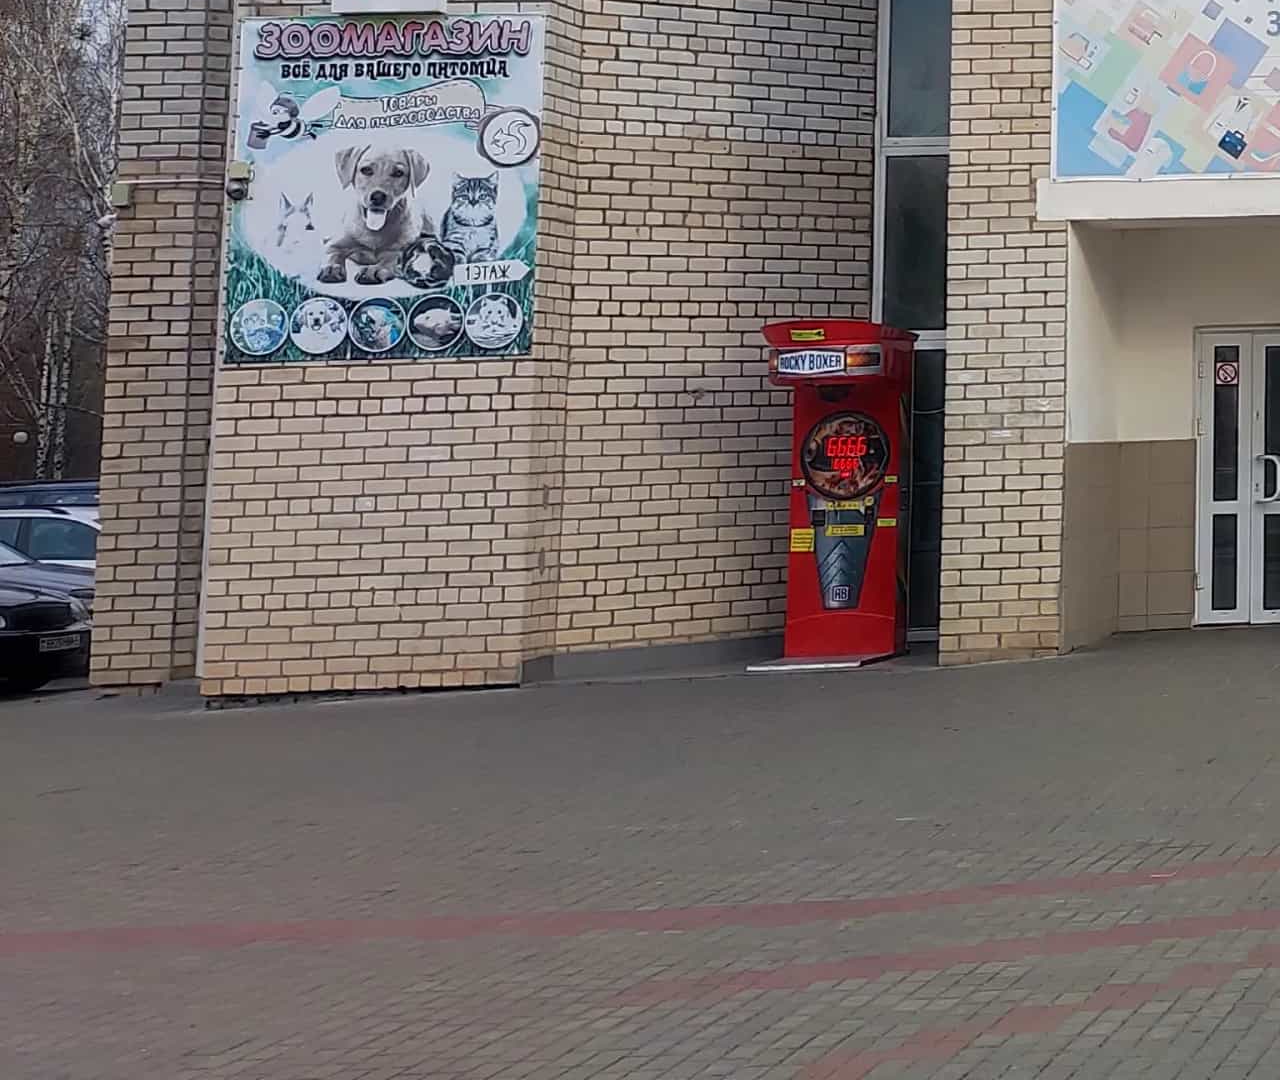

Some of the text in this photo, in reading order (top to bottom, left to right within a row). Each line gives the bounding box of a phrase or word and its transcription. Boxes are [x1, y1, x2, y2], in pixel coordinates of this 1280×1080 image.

[254, 18, 531, 60] ЗООМАГАЗИН
[315, 62, 349, 81] ДЛЯ
[354, 60, 421, 81] ВАШЕГО
[379, 94, 438, 112] ТОВАРЫ
[334, 106, 482, 129] ДЛЯ ПЧЕЛОВОДСТВА
[808, 353, 841, 370] BOXER
